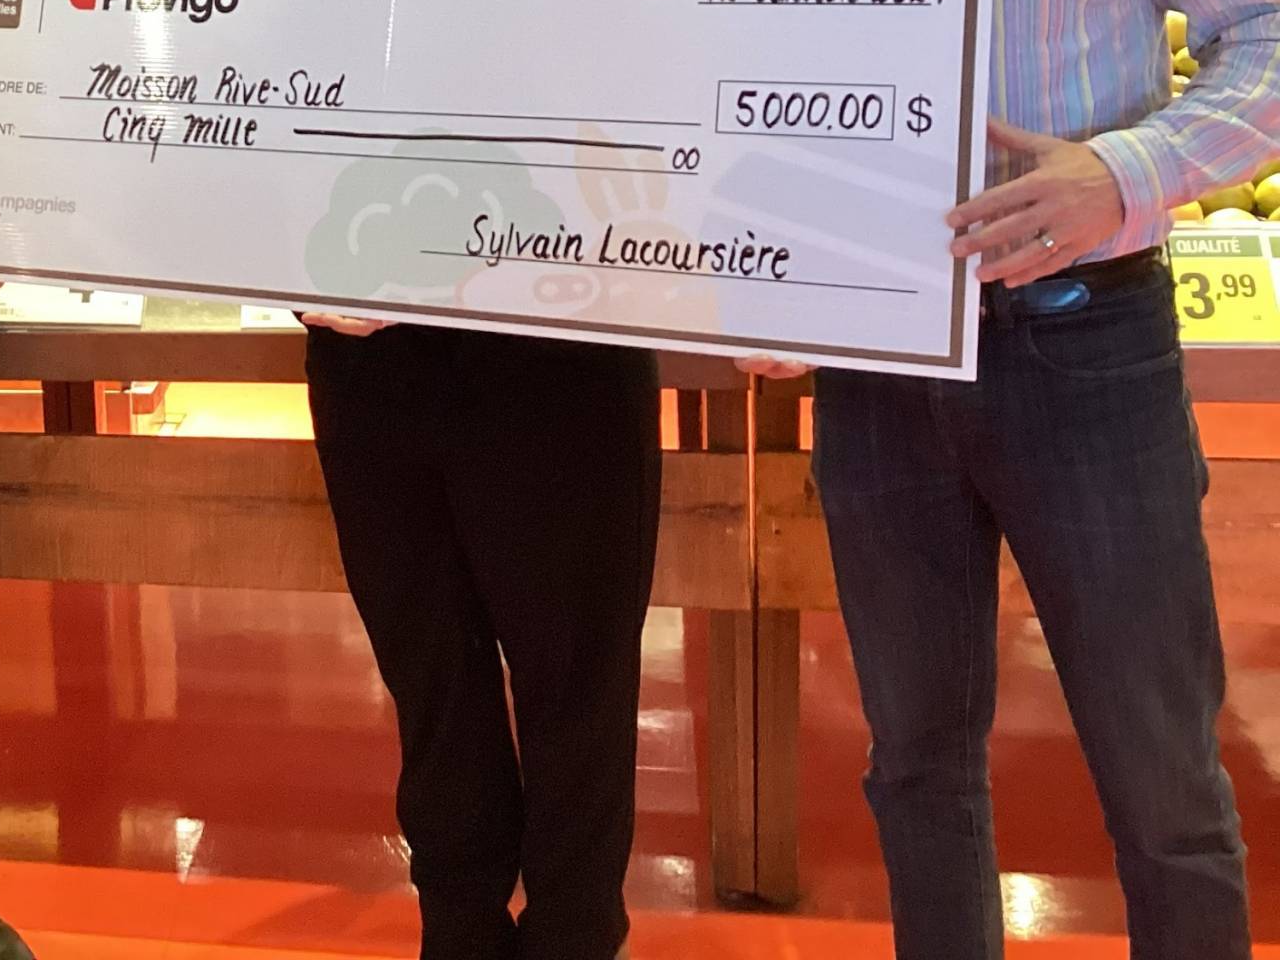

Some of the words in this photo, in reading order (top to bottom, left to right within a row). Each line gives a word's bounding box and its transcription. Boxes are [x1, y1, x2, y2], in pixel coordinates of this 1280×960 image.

[25, 81, 48, 95] DE:
[86, 61, 198, 104] Moisson
[214, 65, 345, 107] Rive-Sud
[735, 90, 883, 130] 5000.00
[906, 93, 933, 137] $
[102, 106, 167, 164] Cinq
[466, 214, 585, 267] Sylvain
[598, 223, 791, 279] Lacoursière
[1175, 236, 1241, 254] QUALITÉ
[1179, 272, 1257, 320] 3,99
